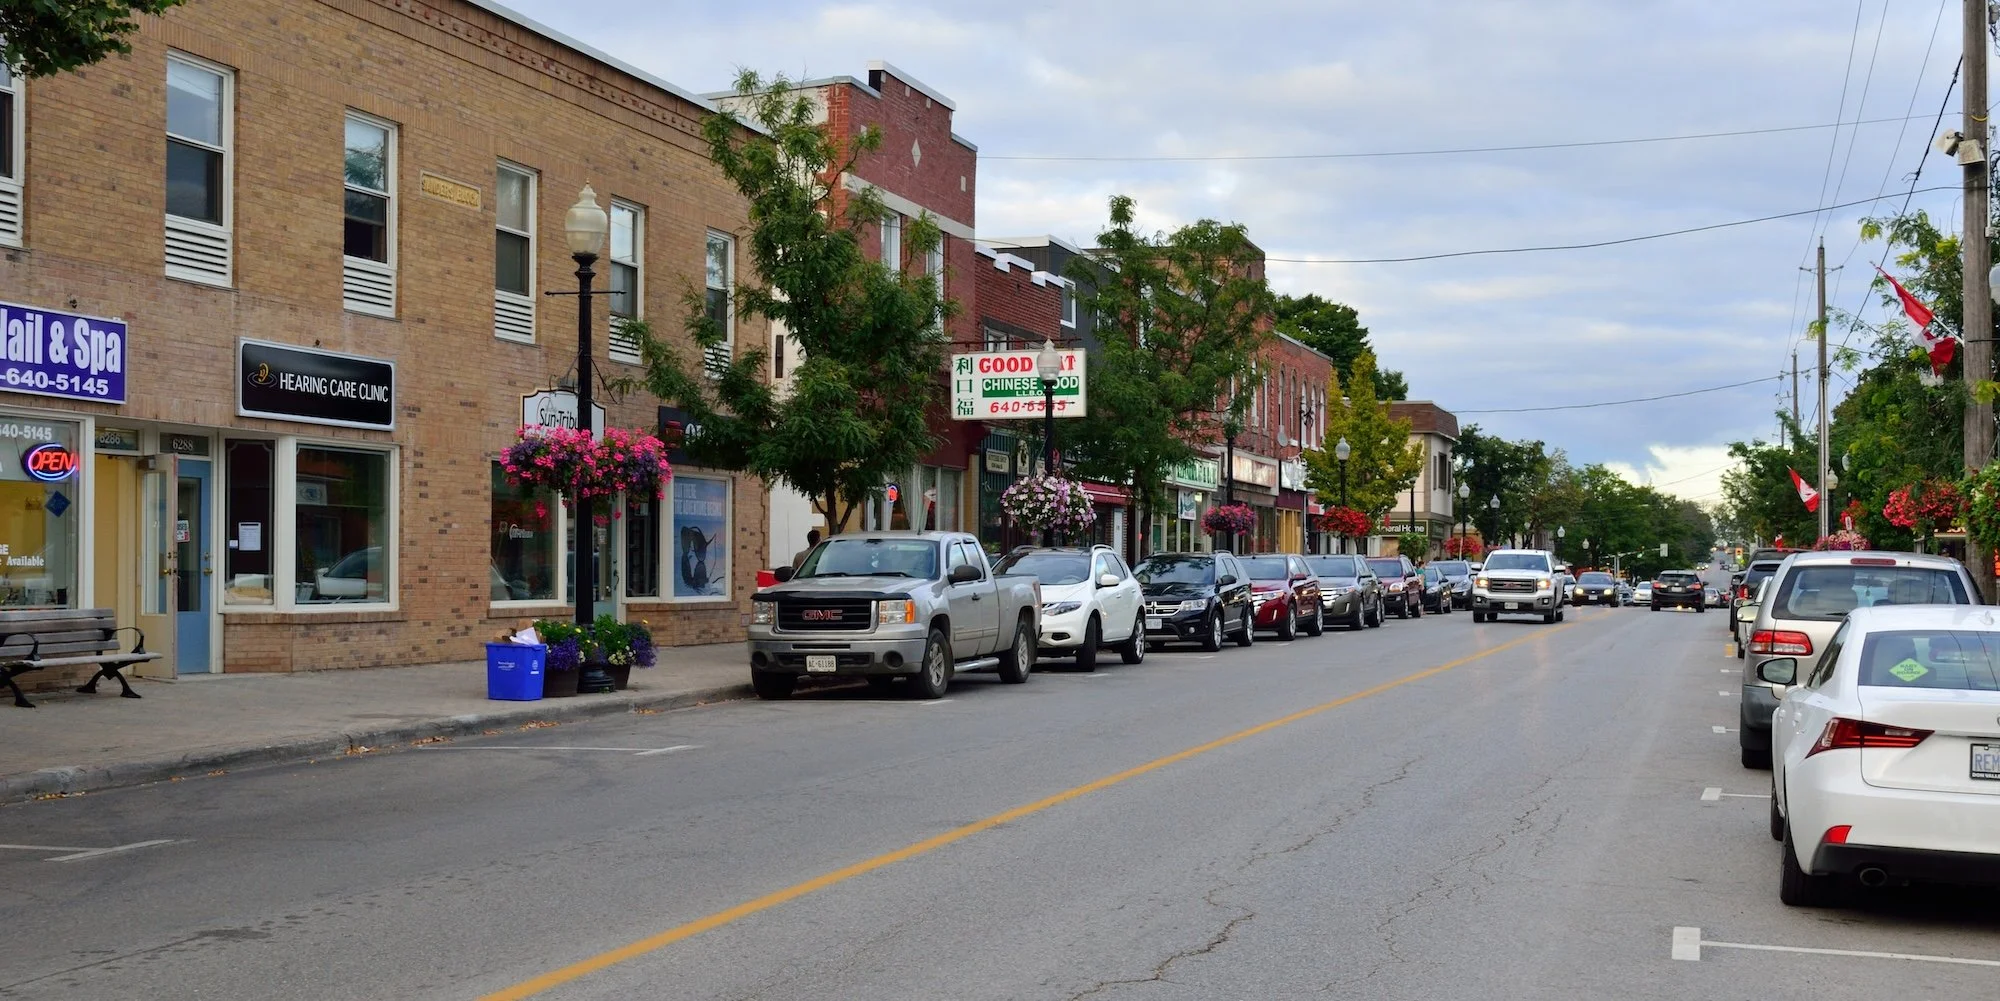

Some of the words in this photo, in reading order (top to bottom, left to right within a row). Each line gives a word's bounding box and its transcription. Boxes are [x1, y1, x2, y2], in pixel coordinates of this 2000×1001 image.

[49, 320, 69, 365] &
[74, 318, 121, 376] Spa
[979, 356, 1033, 374] GOOD
[279, 372, 328, 396] HEARING
[329, 379, 357, 399] CARE
[359, 383, 389, 403] CLINIC
[956, 356, 974, 416] 利口福
[982, 378, 1038, 392] CHINESE
[1043, 376, 1079, 390] OOD
[0, 423, 52, 441] 40-5145
[172, 438, 194, 451] 6288
[32, 451, 76, 471] OPEN
[6, 556, 45, 567] Available
[802, 609, 843, 621] GMC
